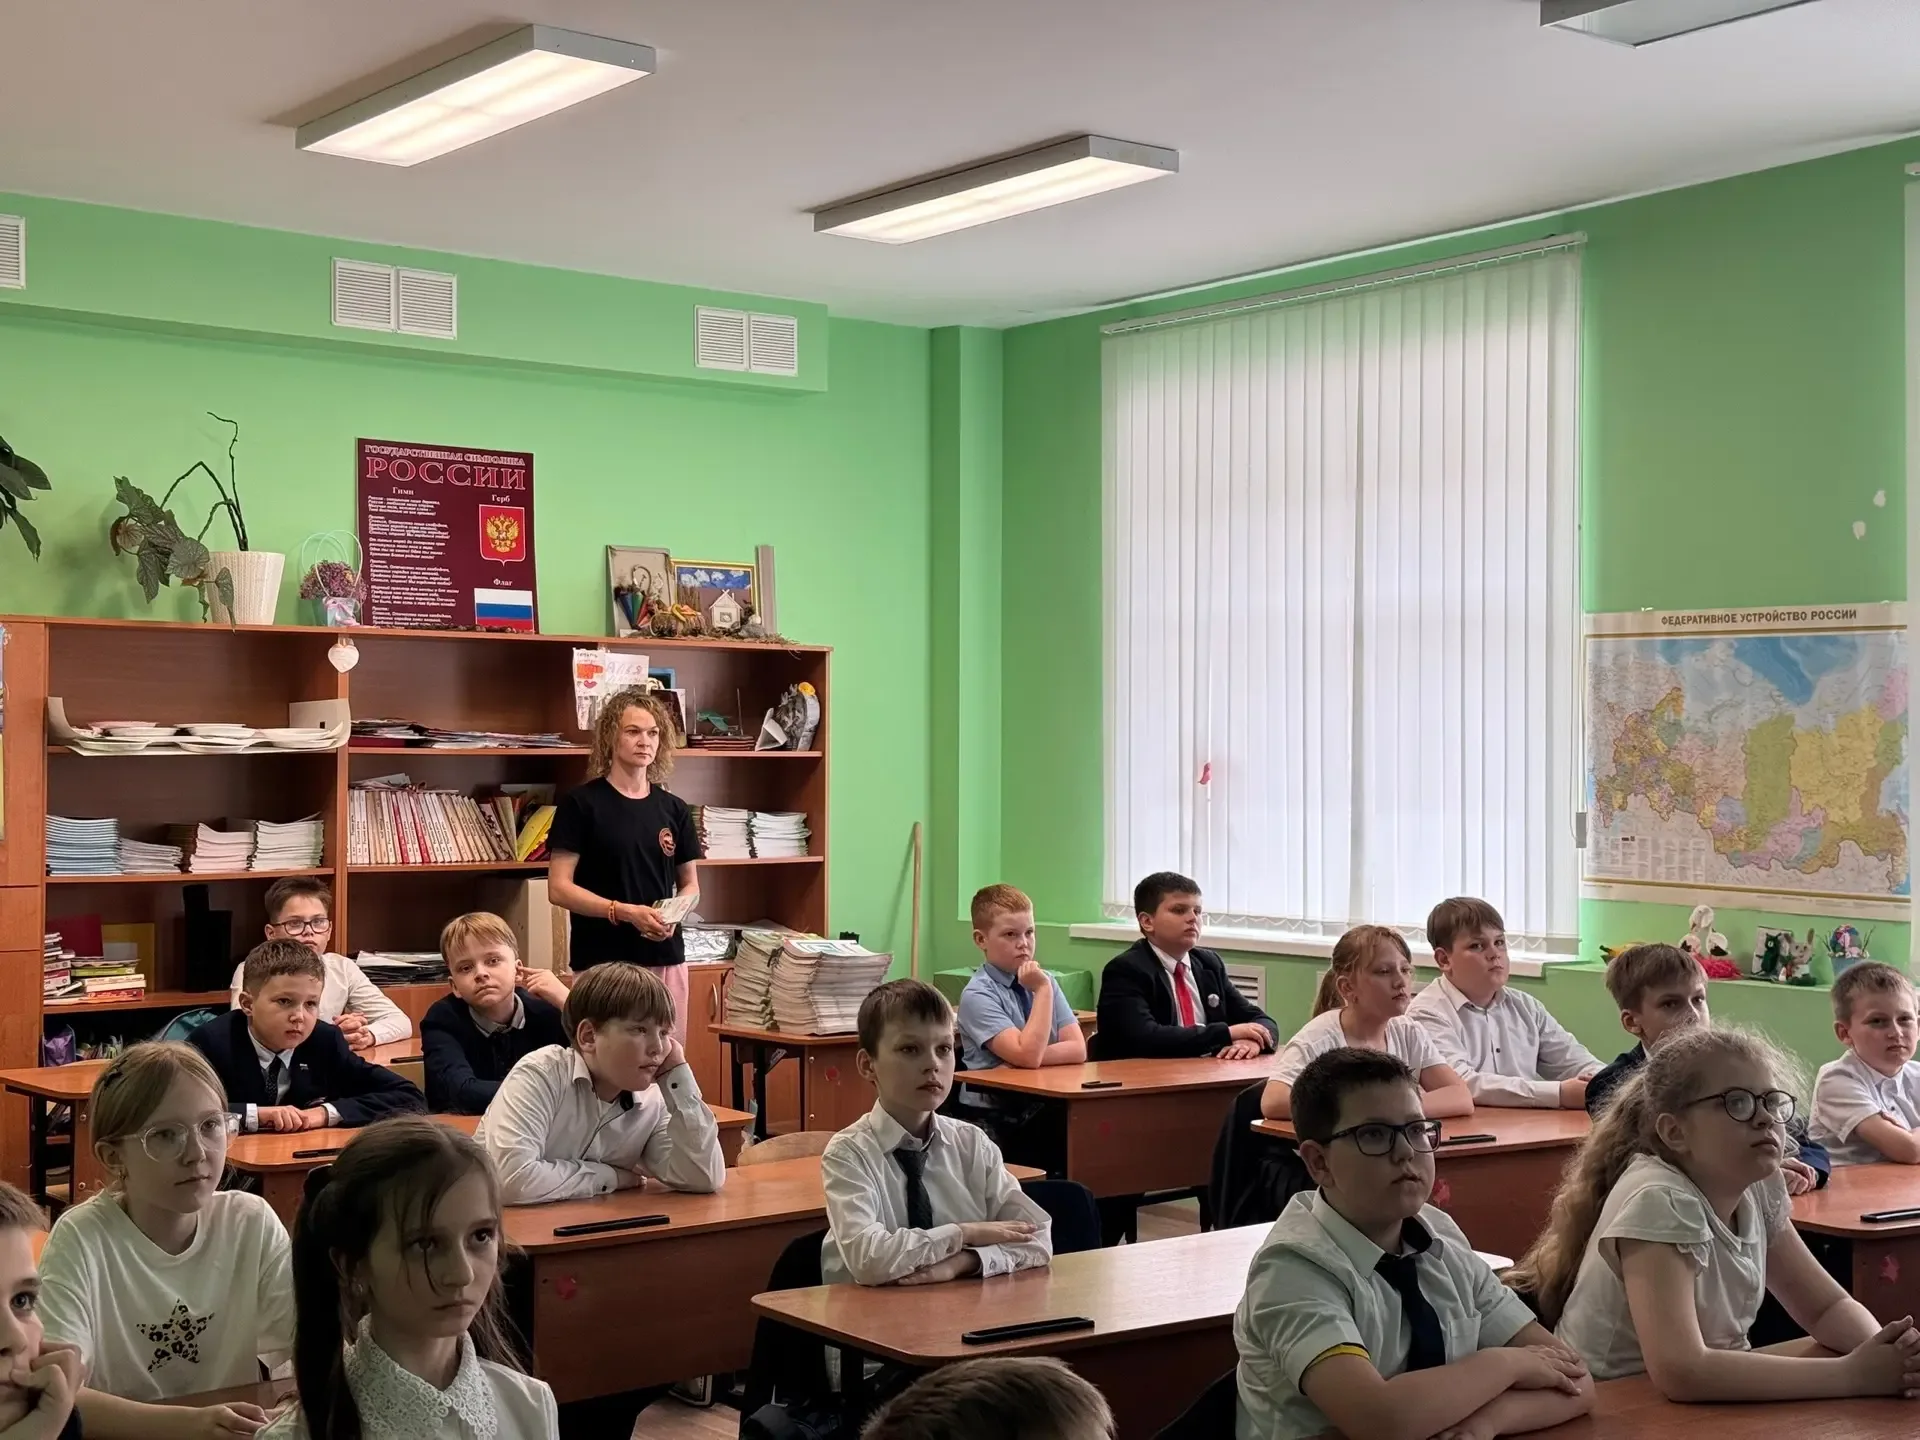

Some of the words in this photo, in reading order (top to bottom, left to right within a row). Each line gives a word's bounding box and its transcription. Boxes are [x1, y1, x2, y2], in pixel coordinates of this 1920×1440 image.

[364, 444, 463, 461] ГОСУДАРСТВЕННАЯ
[365, 456, 527, 491] РОССИИ
[392, 486, 414, 495] Гимн
[491, 494, 511, 504] Герб
[493, 578, 513, 587] Флаг
[1661, 612, 1737, 626] ФЕДЕРАТИВНОЕ
[1740, 609, 1808, 624] УСТРОЙСТВО
[1811, 608, 1857, 621] РОССИИ
